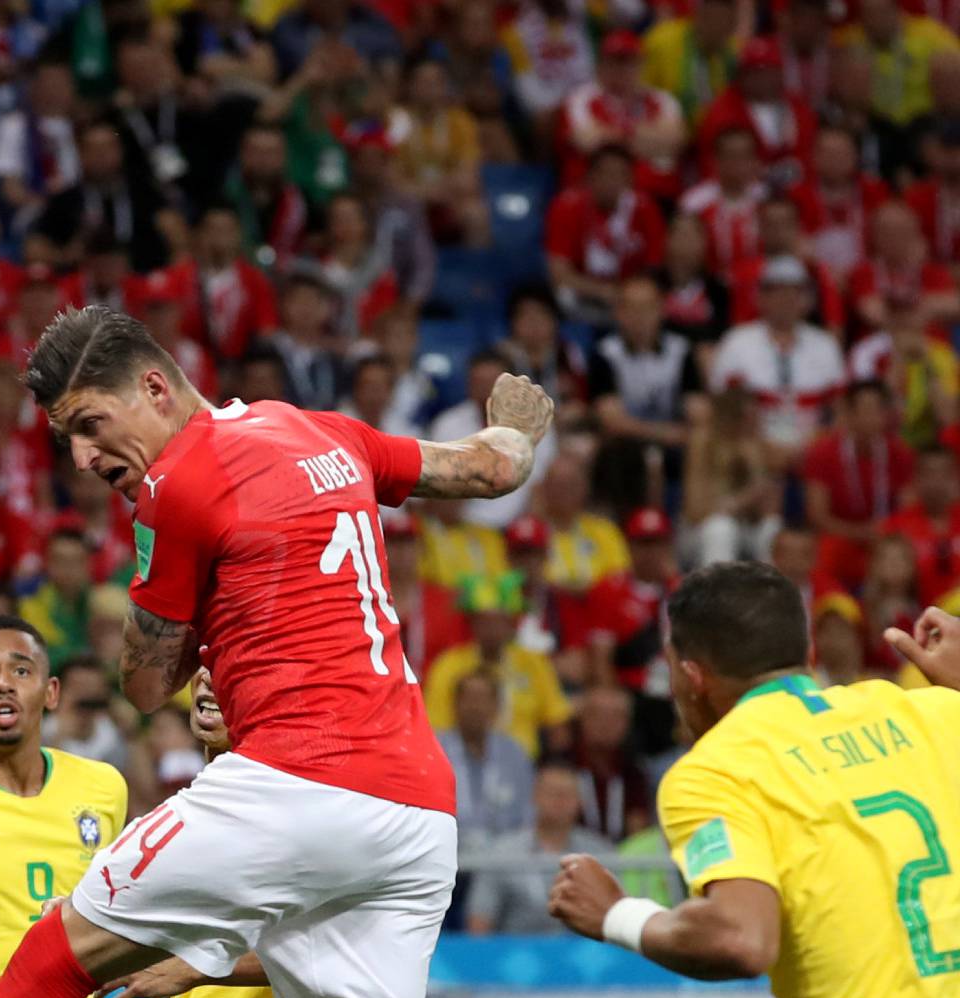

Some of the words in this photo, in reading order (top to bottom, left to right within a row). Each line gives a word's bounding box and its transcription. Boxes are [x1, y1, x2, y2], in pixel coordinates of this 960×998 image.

[820, 717, 914, 769] SILVA
[26, 861, 54, 922] 9
[851, 790, 960, 978] 2
